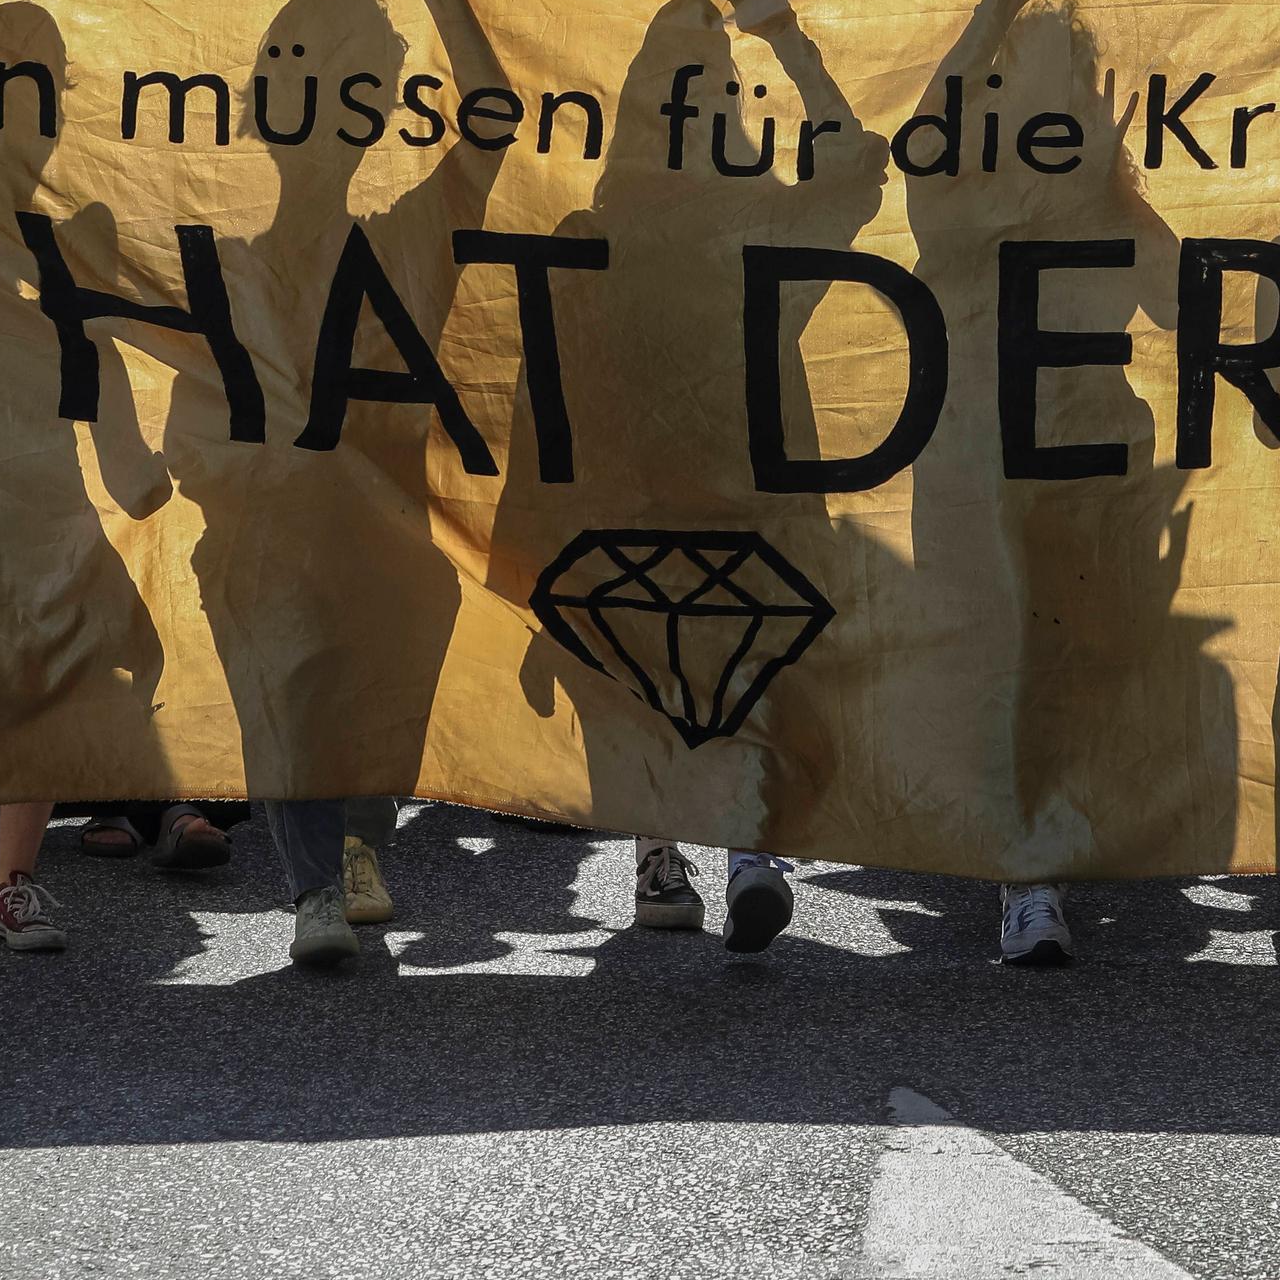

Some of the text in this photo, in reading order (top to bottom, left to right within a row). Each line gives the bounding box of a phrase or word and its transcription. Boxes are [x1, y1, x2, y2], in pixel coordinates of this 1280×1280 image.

[121, 43, 604, 159] müssen
[660, 64, 841, 181] für
[889, 72, 1085, 176] die
[14, 210, 609, 485] HAT
